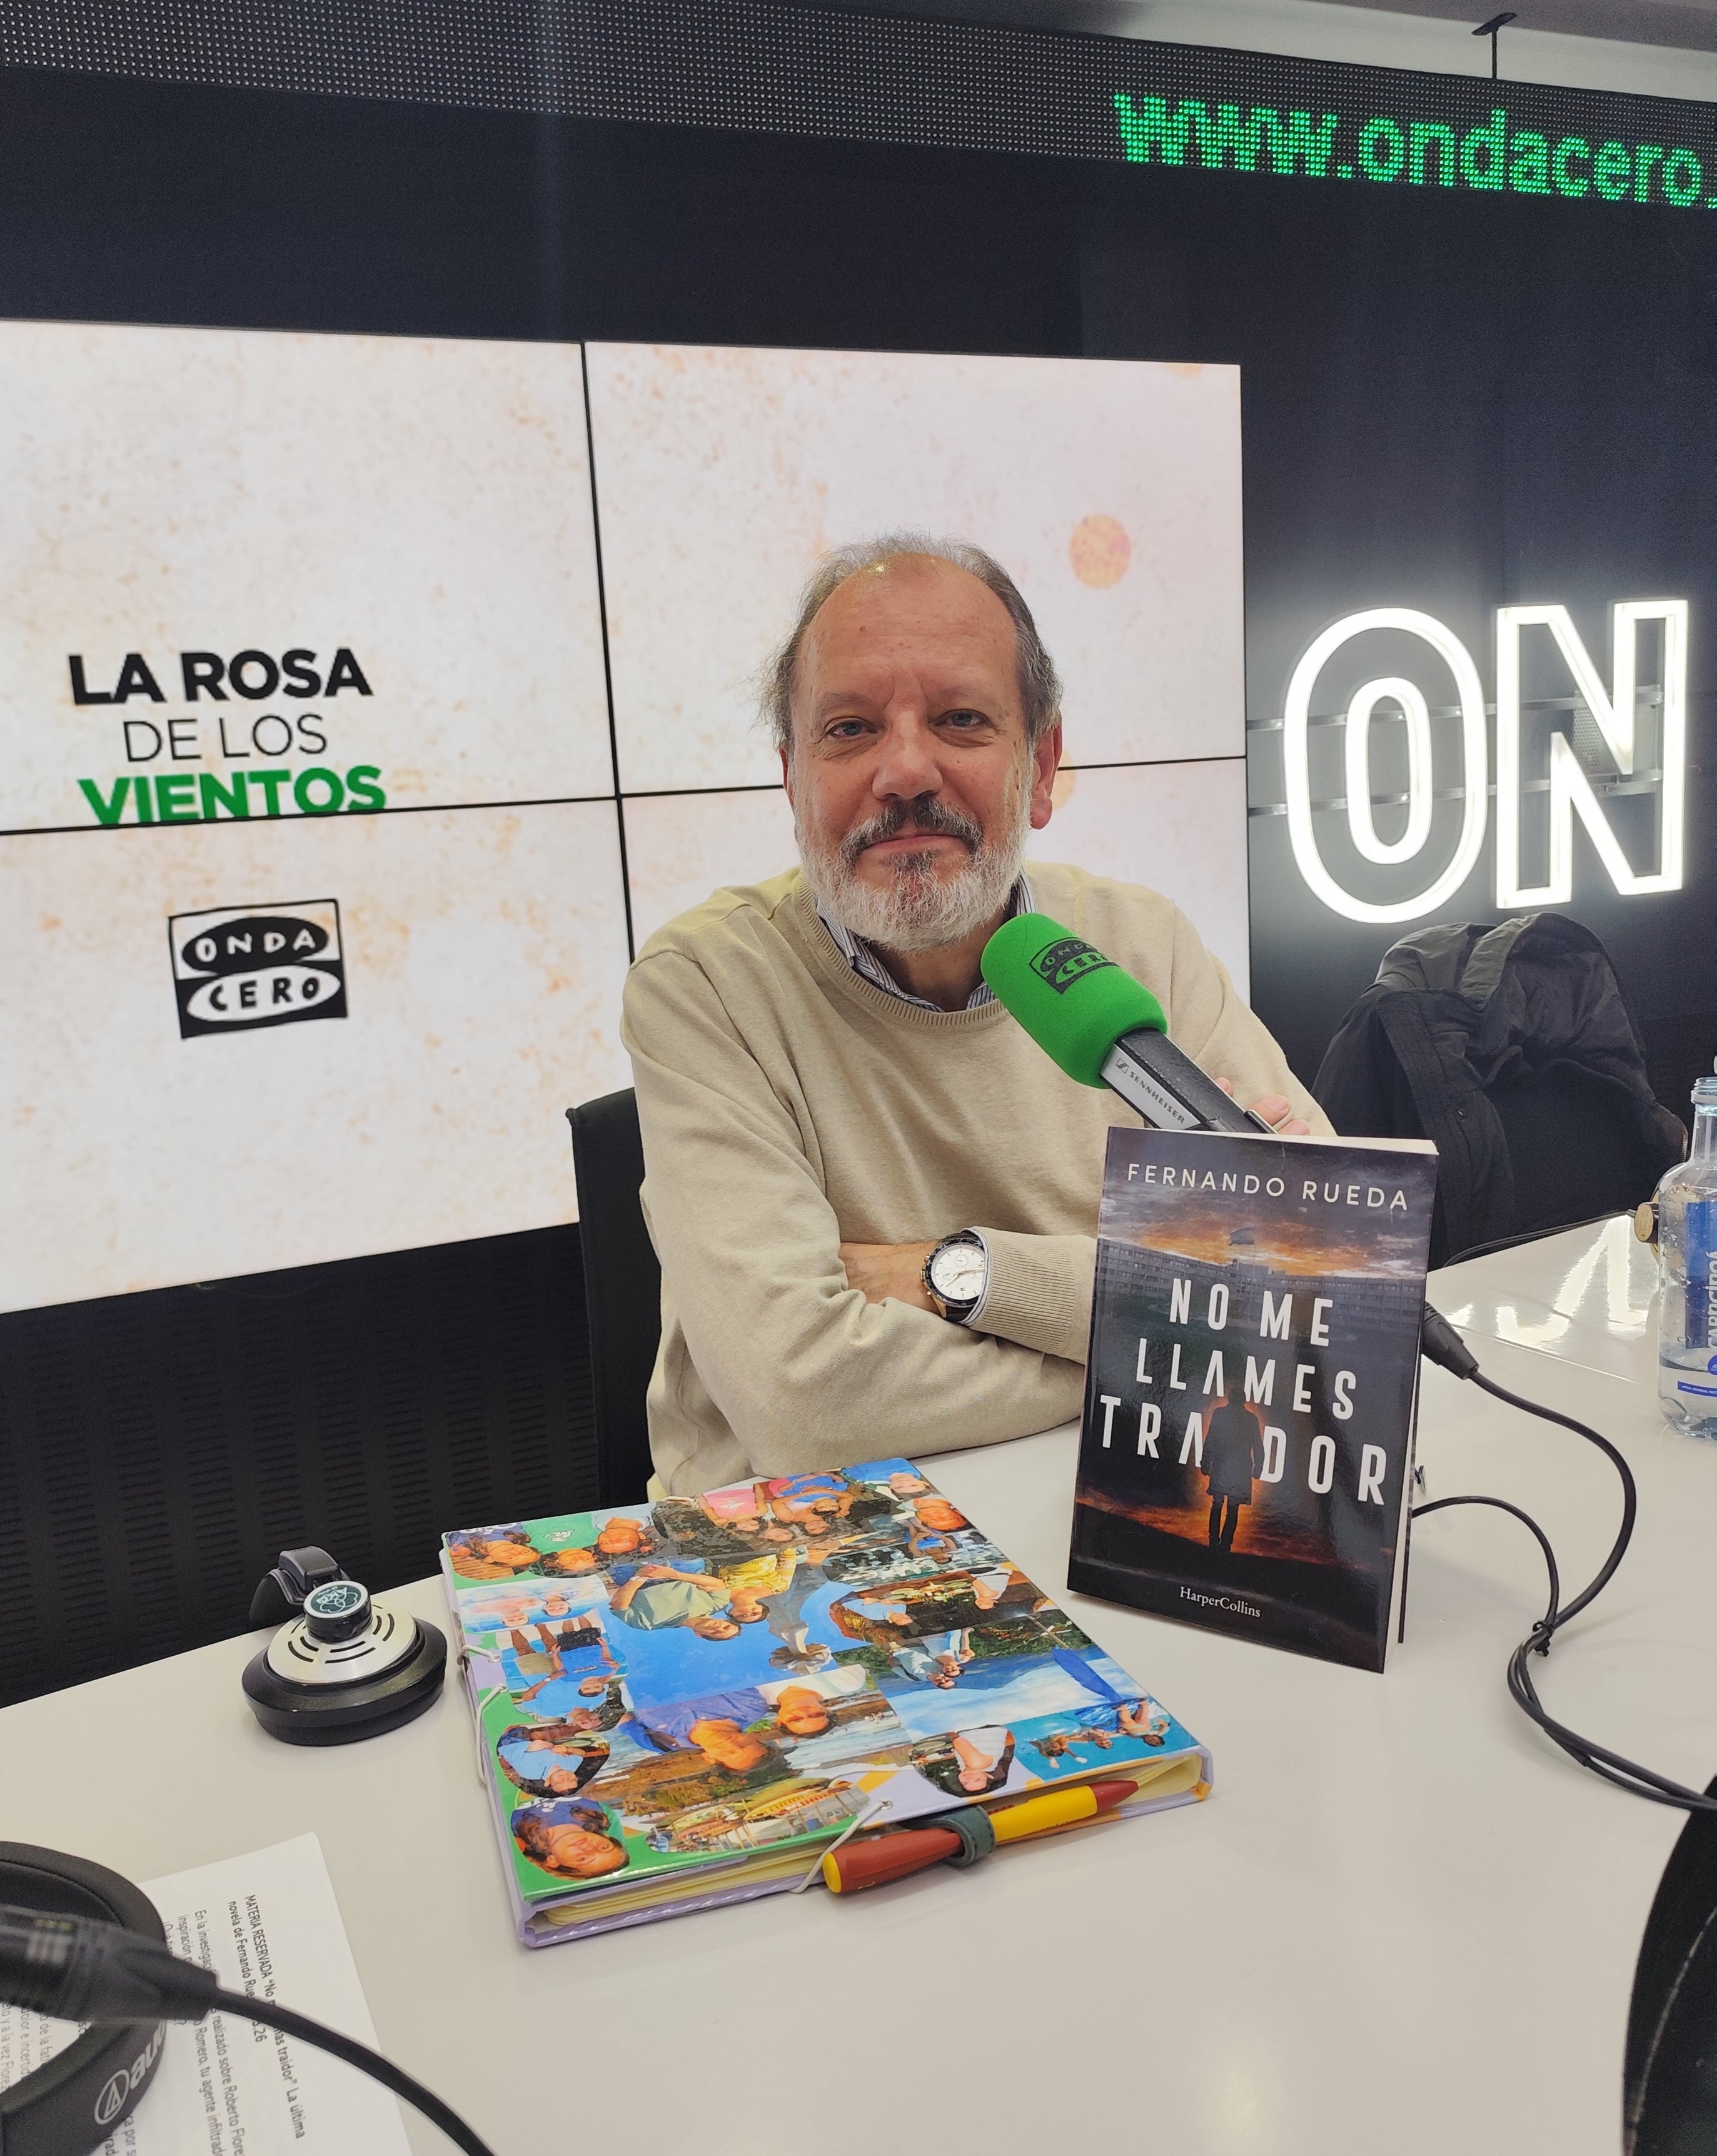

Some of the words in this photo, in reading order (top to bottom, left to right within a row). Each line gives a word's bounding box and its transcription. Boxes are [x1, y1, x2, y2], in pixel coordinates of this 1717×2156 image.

[69, 653, 167, 706] LA
[181, 647, 374, 702] ROSA
[123, 718, 202, 762] DE
[219, 714, 327, 758] LOS
[1283, 600, 1689, 924] ON
[78, 765, 386, 825] VIENTOS
[194, 929, 316, 962] ONDA
[209, 977, 320, 1012] CERO
[1128, 1069, 1186, 1125] SENNHEISER
[1127, 1163, 1285, 1197] FERNANDO
[1302, 1181, 1409, 1211] RUEDA
[1169, 1277, 1229, 1331] NO
[1259, 1291, 1333, 1347] ME
[1135, 1337, 1356, 1420] LLAMES
[1179, 1586, 1261, 1618] HarperCollins
[194, 1909, 207, 1921] En
[196, 1920, 208, 1930] la
[228, 1901, 243, 1927] novela
[244, 1895, 262, 1930] MATERIA
[176, 1914, 194, 1956] inspiración
[233, 1927, 245, 1938] de
[236, 1938, 254, 1978] Fernando
[252, 1928, 273, 1979] RESERVADA
[39, 2023, 52, 2035] de
[39, 2035, 53, 2046] la
[212, 2015, 229, 2056] realizado
[1, 2043, 12, 2058] vez
[199, 2066, 211, 2078] tu
[218, 2057, 233, 2085] sobre
[198, 2079, 216, 2113] agente
[224, 2085, 239, 2127] Roberto
[286, 2087, 299, 2103] La
[121, 2128, 136, 2146] por
[290, 2104, 306, 2139] última
